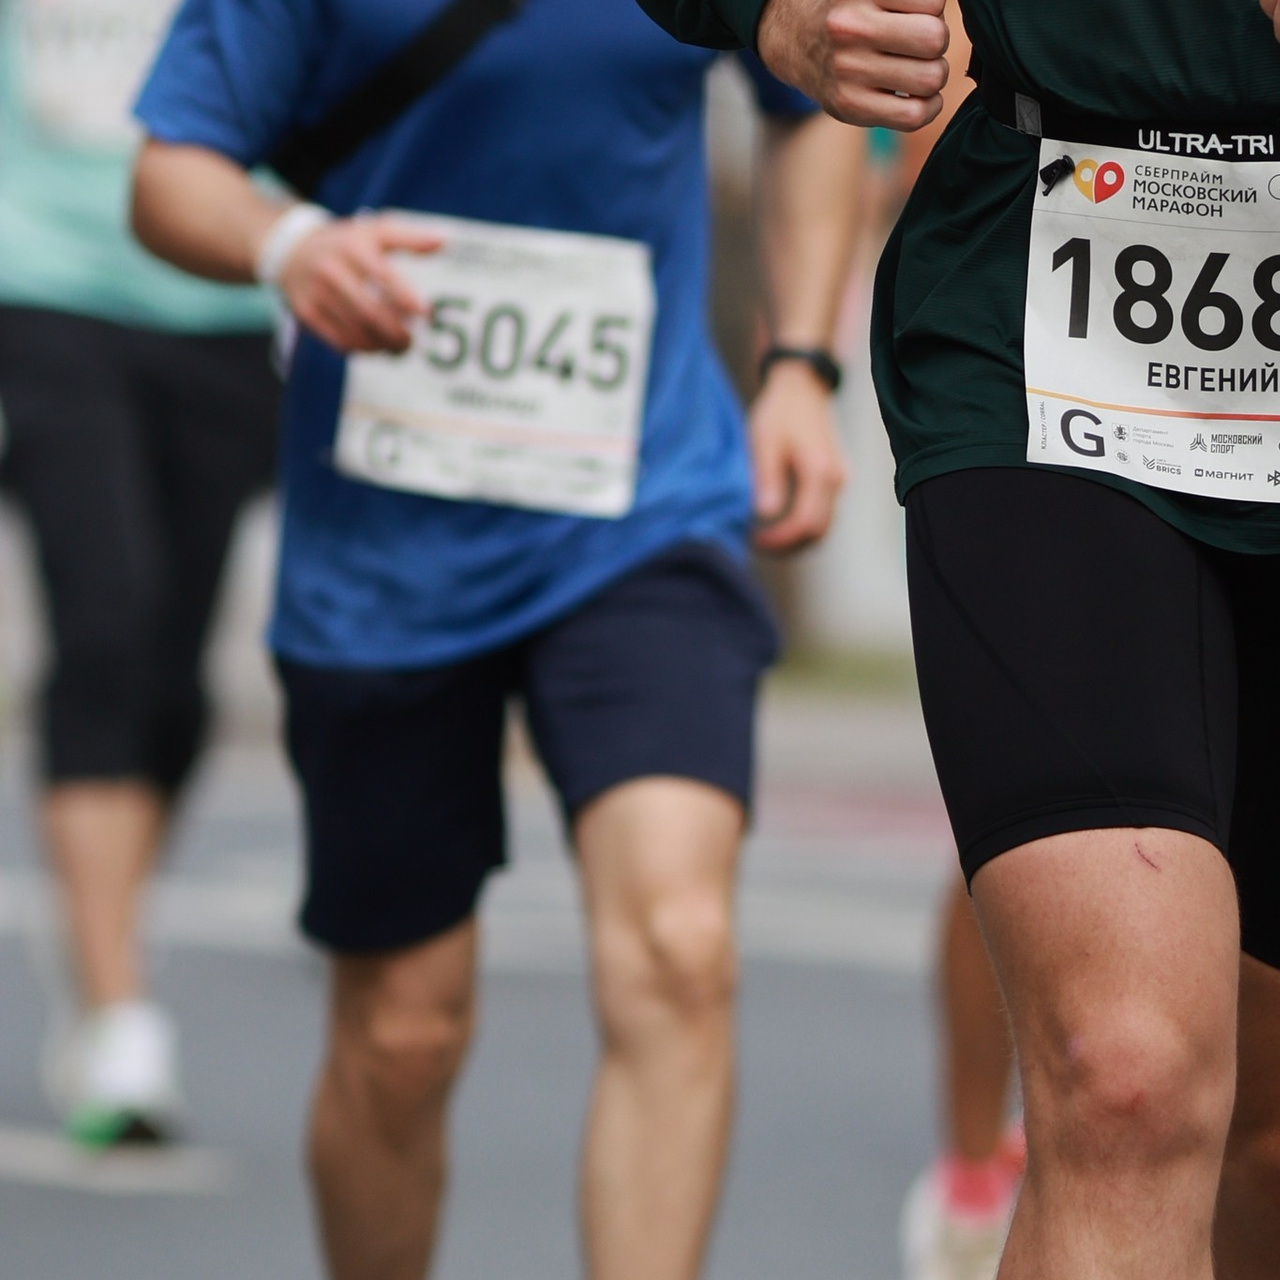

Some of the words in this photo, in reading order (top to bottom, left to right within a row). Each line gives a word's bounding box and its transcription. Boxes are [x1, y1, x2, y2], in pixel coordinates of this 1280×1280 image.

[1138, 128, 1274, 155] ULTRA-TRI
[1134, 164, 1223, 185] СБЕРПРАЙМ
[1133, 179, 1258, 203] МОСКОВСКИЙ
[1132, 196, 1224, 218] МАРАФОН
[1146, 362, 1279, 393] ЕВГЕНИЙ
[1060, 408, 1106, 458] G
[1210, 433, 1263, 446] МОСКОВСКИЙ
[1210, 444, 1235, 454] СПОРТ
[1156, 465, 1182, 475] BRICS
